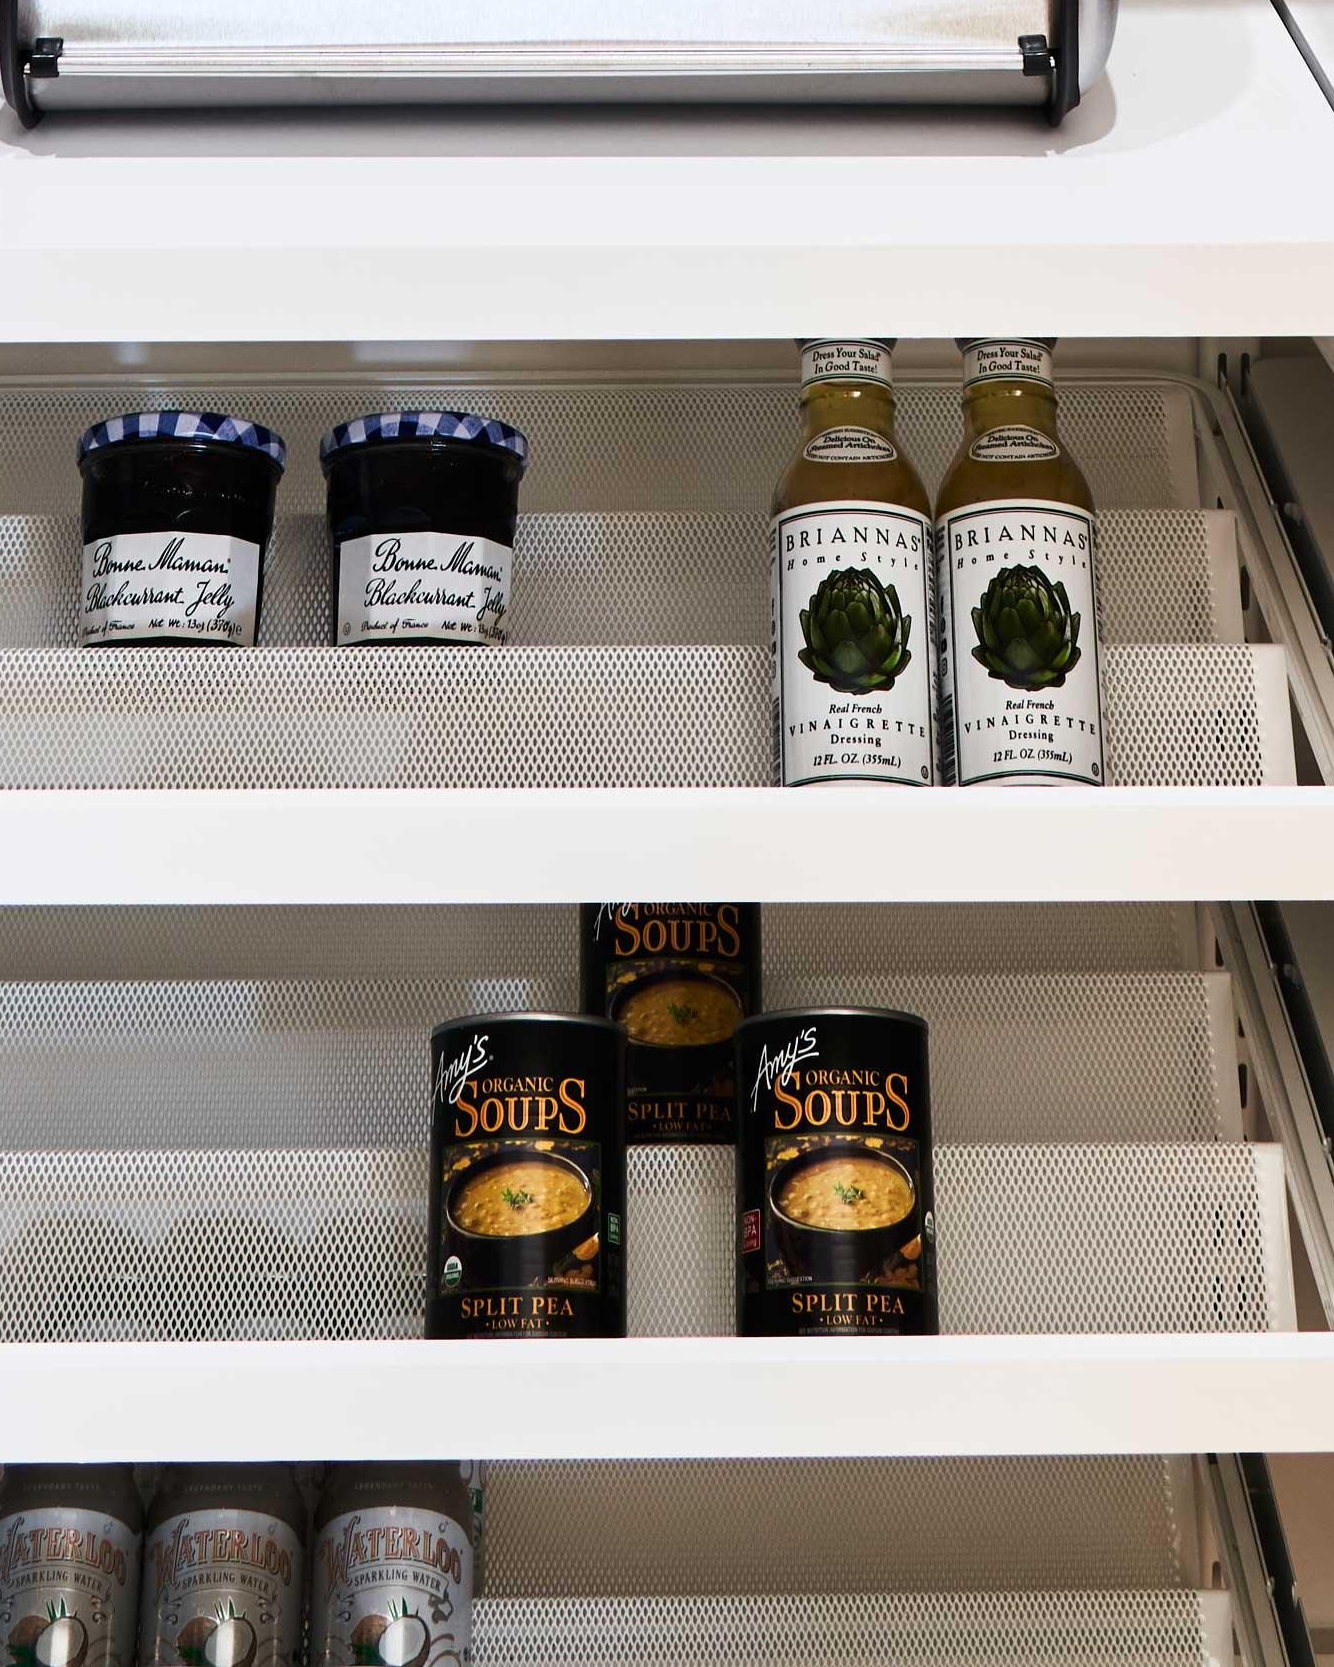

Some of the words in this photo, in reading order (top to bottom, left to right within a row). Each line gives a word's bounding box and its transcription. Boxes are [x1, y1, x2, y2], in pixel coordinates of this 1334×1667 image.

[812, 350, 835, 362] Dress
[837, 348, 857, 360] Your
[858, 349, 880, 362] Salad
[977, 350, 998, 362] Dress
[1000, 348, 1019, 359] Your
[1021, 349, 1043, 362] Salad
[814, 363, 824, 374] In
[825, 361, 851, 373] Good
[853, 361, 878, 374] Taste!
[978, 363, 987, 374] In
[988, 361, 1013, 372] Good
[1015, 361, 1040, 374] Taste!
[823, 435, 860, 444] Delicious
[988, 434, 1025, 443] Delicious
[786, 527, 918, 552] BRIANNAS
[955, 524, 1085, 551] BRIANNAS
[93, 541, 145, 578] Bonne
[149, 537, 229, 573] Maman
[373, 538, 437, 572] Bonne
[440, 541, 502, 582] Maman
[787, 554, 841, 571] Home
[861, 552, 918, 571] Style
[957, 552, 1009, 569] Home
[1029, 549, 1086, 568] Style
[85, 580, 184, 613] Blackcurrant
[185, 579, 234, 618] Jelly
[364, 578, 475, 608] Blackcurrant
[476, 586, 506, 626] Jelly
[109, 621, 134, 631] France
[148, 618, 163, 629] Net
[361, 621, 387, 632] Product
[389, 617, 399, 634] of
[402, 619, 428, 629] France
[441, 620, 456, 630] Net
[829, 704, 849, 714] Real
[851, 703, 882, 714] French
[1006, 700, 1024, 710] Real
[1026, 699, 1054, 710] French
[790, 718, 925, 738] VINAIGRETTE
[964, 714, 1095, 734] VINAIGRETTE
[830, 734, 882, 747] Dressing
[1009, 730, 1054, 743] Dressing
[813, 756, 821, 766] 12
[823, 754, 838, 765] FL.
[841, 753, 859, 764] OZ.
[863, 754, 902, 769] (355mL)
[993, 753, 1002, 762] 12
[1004, 750, 1017, 760] FL.
[1020, 749, 1035, 759] OZ.
[1037, 749, 1072, 764] (355mL)
[644, 903, 712, 916] ORGANIC
[750, 1027, 819, 1113] Amy's
[806, 1070, 880, 1086] ORGANIC
[432, 1034, 489, 1126] Amy's
[482, 1077, 554, 1094] ORGANIC
[455, 1078, 586, 1137] SOUPS
[774, 1071, 910, 1132] SOUPS
[628, 1100, 688, 1122] SPLIT
[696, 1101, 731, 1123] PEA
[659, 1123, 682, 1131] LOW
[461, 1297, 523, 1318] SPLIT
[531, 1297, 574, 1316] PEA
[792, 1293, 858, 1314] SPLIT
[867, 1294, 904, 1315] PEA
[492, 1318, 516, 1329] LOW
[521, 1318, 543, 1328] FAT
[827, 1315, 852, 1325] LOW
[856, 1315, 877, 1325] FAT
[155, 1518, 292, 1602] WATERLOO
[321, 1515, 461, 1602] WATERLOO
[15, 1570, 69, 1588] SPARKLING
[74, 1571, 103, 1593] WATER
[182, 1572, 235, 1589] SPARKLING
[240, 1572, 269, 1594] WATER
[354, 1569, 408, 1588] SPARKLING
[412, 1571, 441, 1592] WATER
